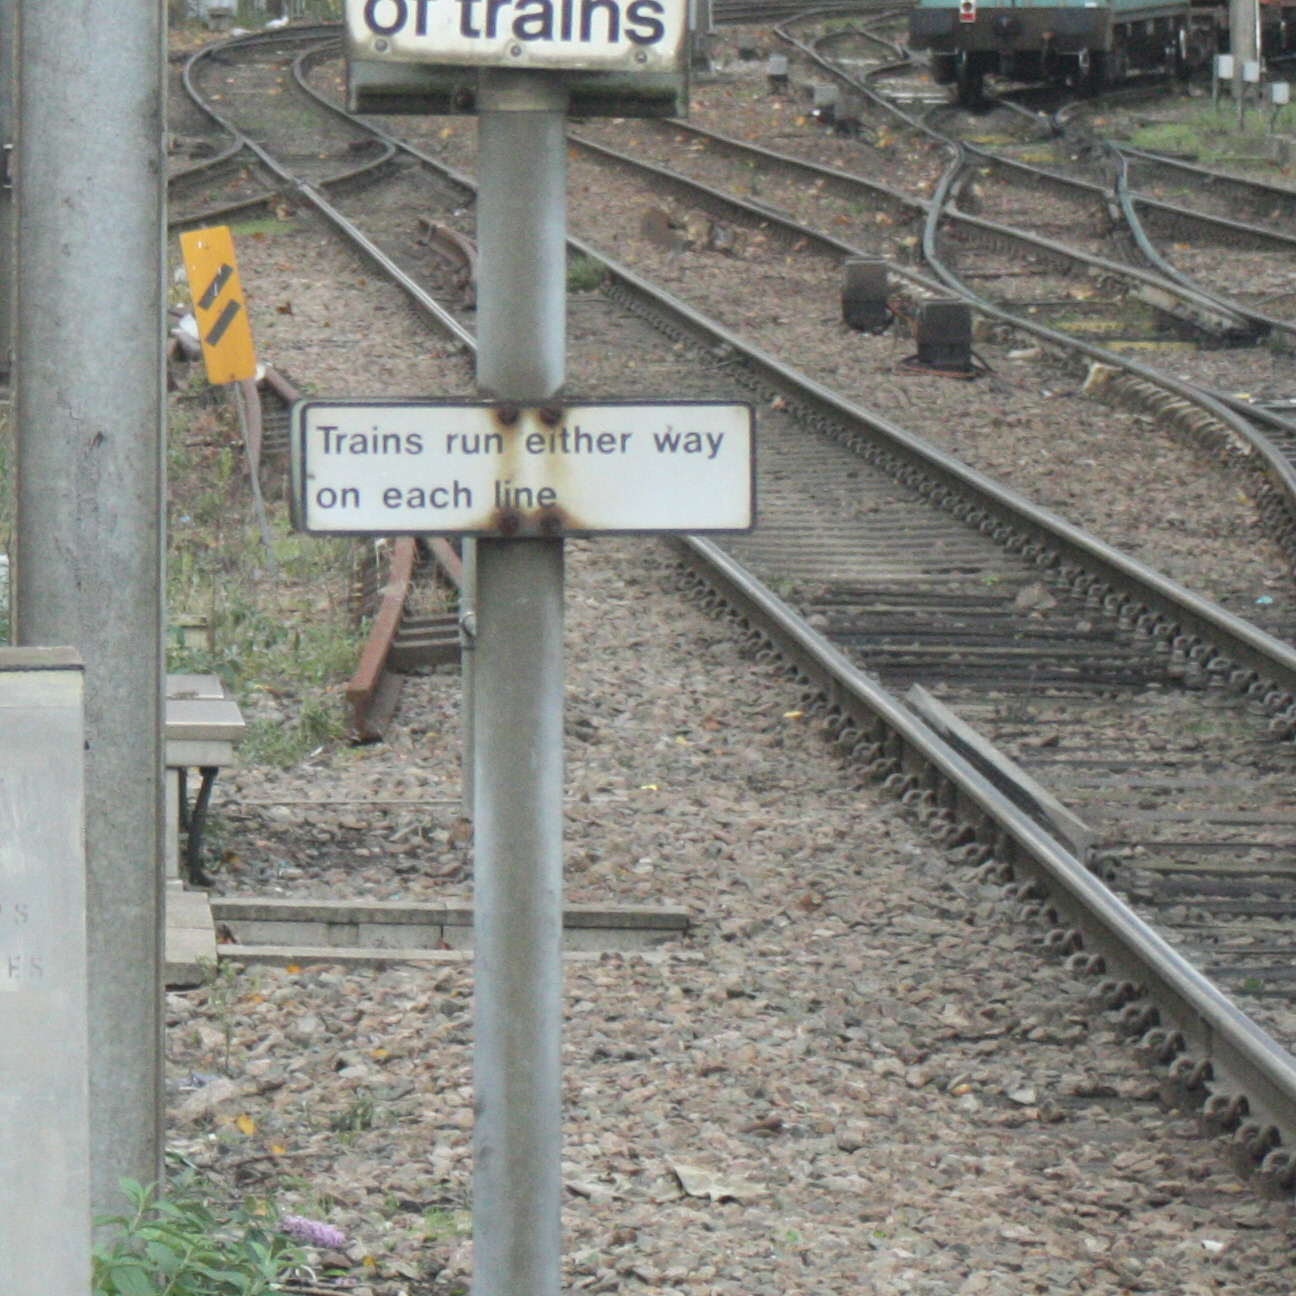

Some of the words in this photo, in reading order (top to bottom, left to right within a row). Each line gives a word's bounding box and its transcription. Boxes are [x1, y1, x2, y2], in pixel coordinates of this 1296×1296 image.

[315, 425, 424, 455] Trains
[446, 432, 505, 455] run
[525, 426, 633, 455] either
[652, 431, 725, 459] way
[315, 485, 360, 509] on
[381, 480, 473, 509] each
[494, 480, 557, 508] line
